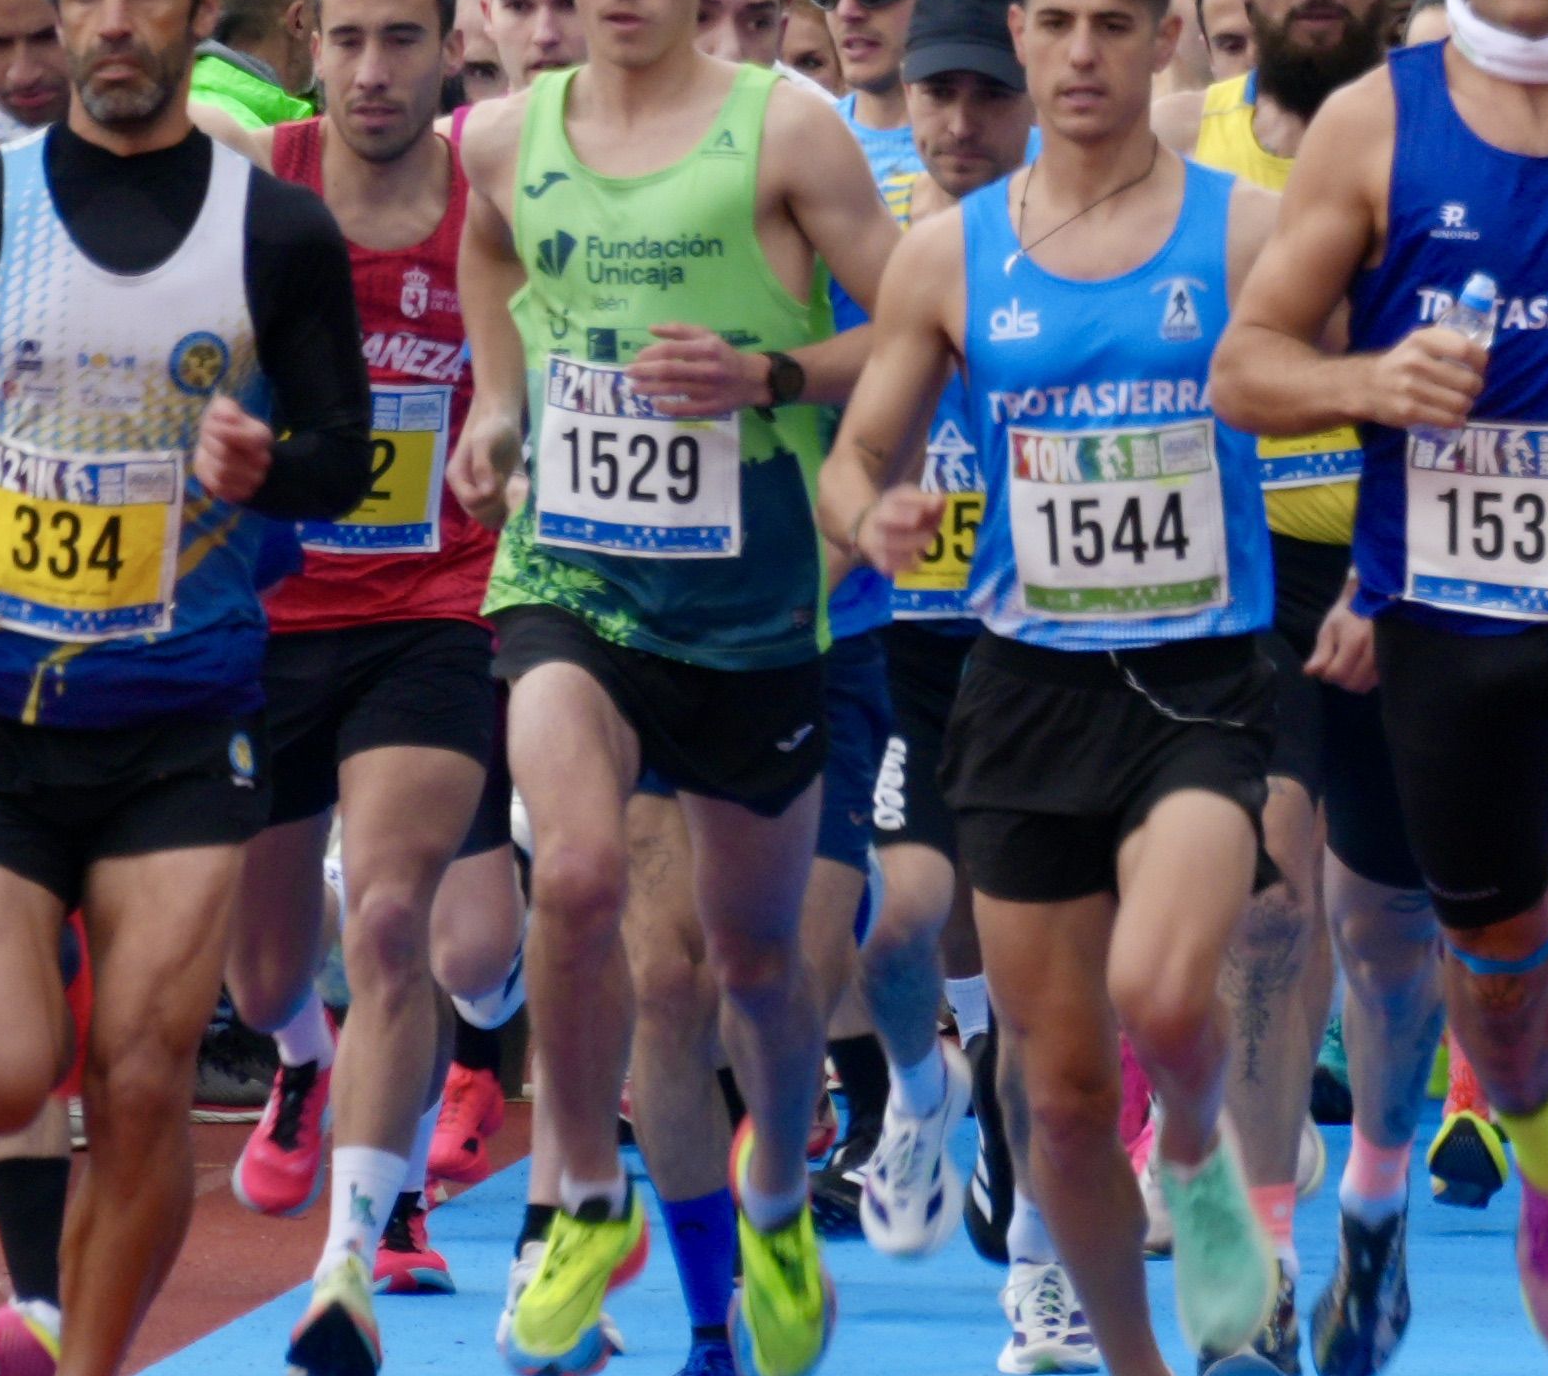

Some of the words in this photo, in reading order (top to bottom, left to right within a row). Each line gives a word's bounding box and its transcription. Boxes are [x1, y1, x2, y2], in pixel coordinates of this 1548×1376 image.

[585, 230, 725, 259] Fundación
[586, 260, 686, 292] Unicaja
[361, 328, 464, 382] AÑEZA
[562, 364, 618, 416] 21K
[562, 426, 701, 505] 1529
[1024, 435, 1086, 484] 10K
[11, 504, 124, 583] 334
[1036, 490, 1190, 568] 1544
